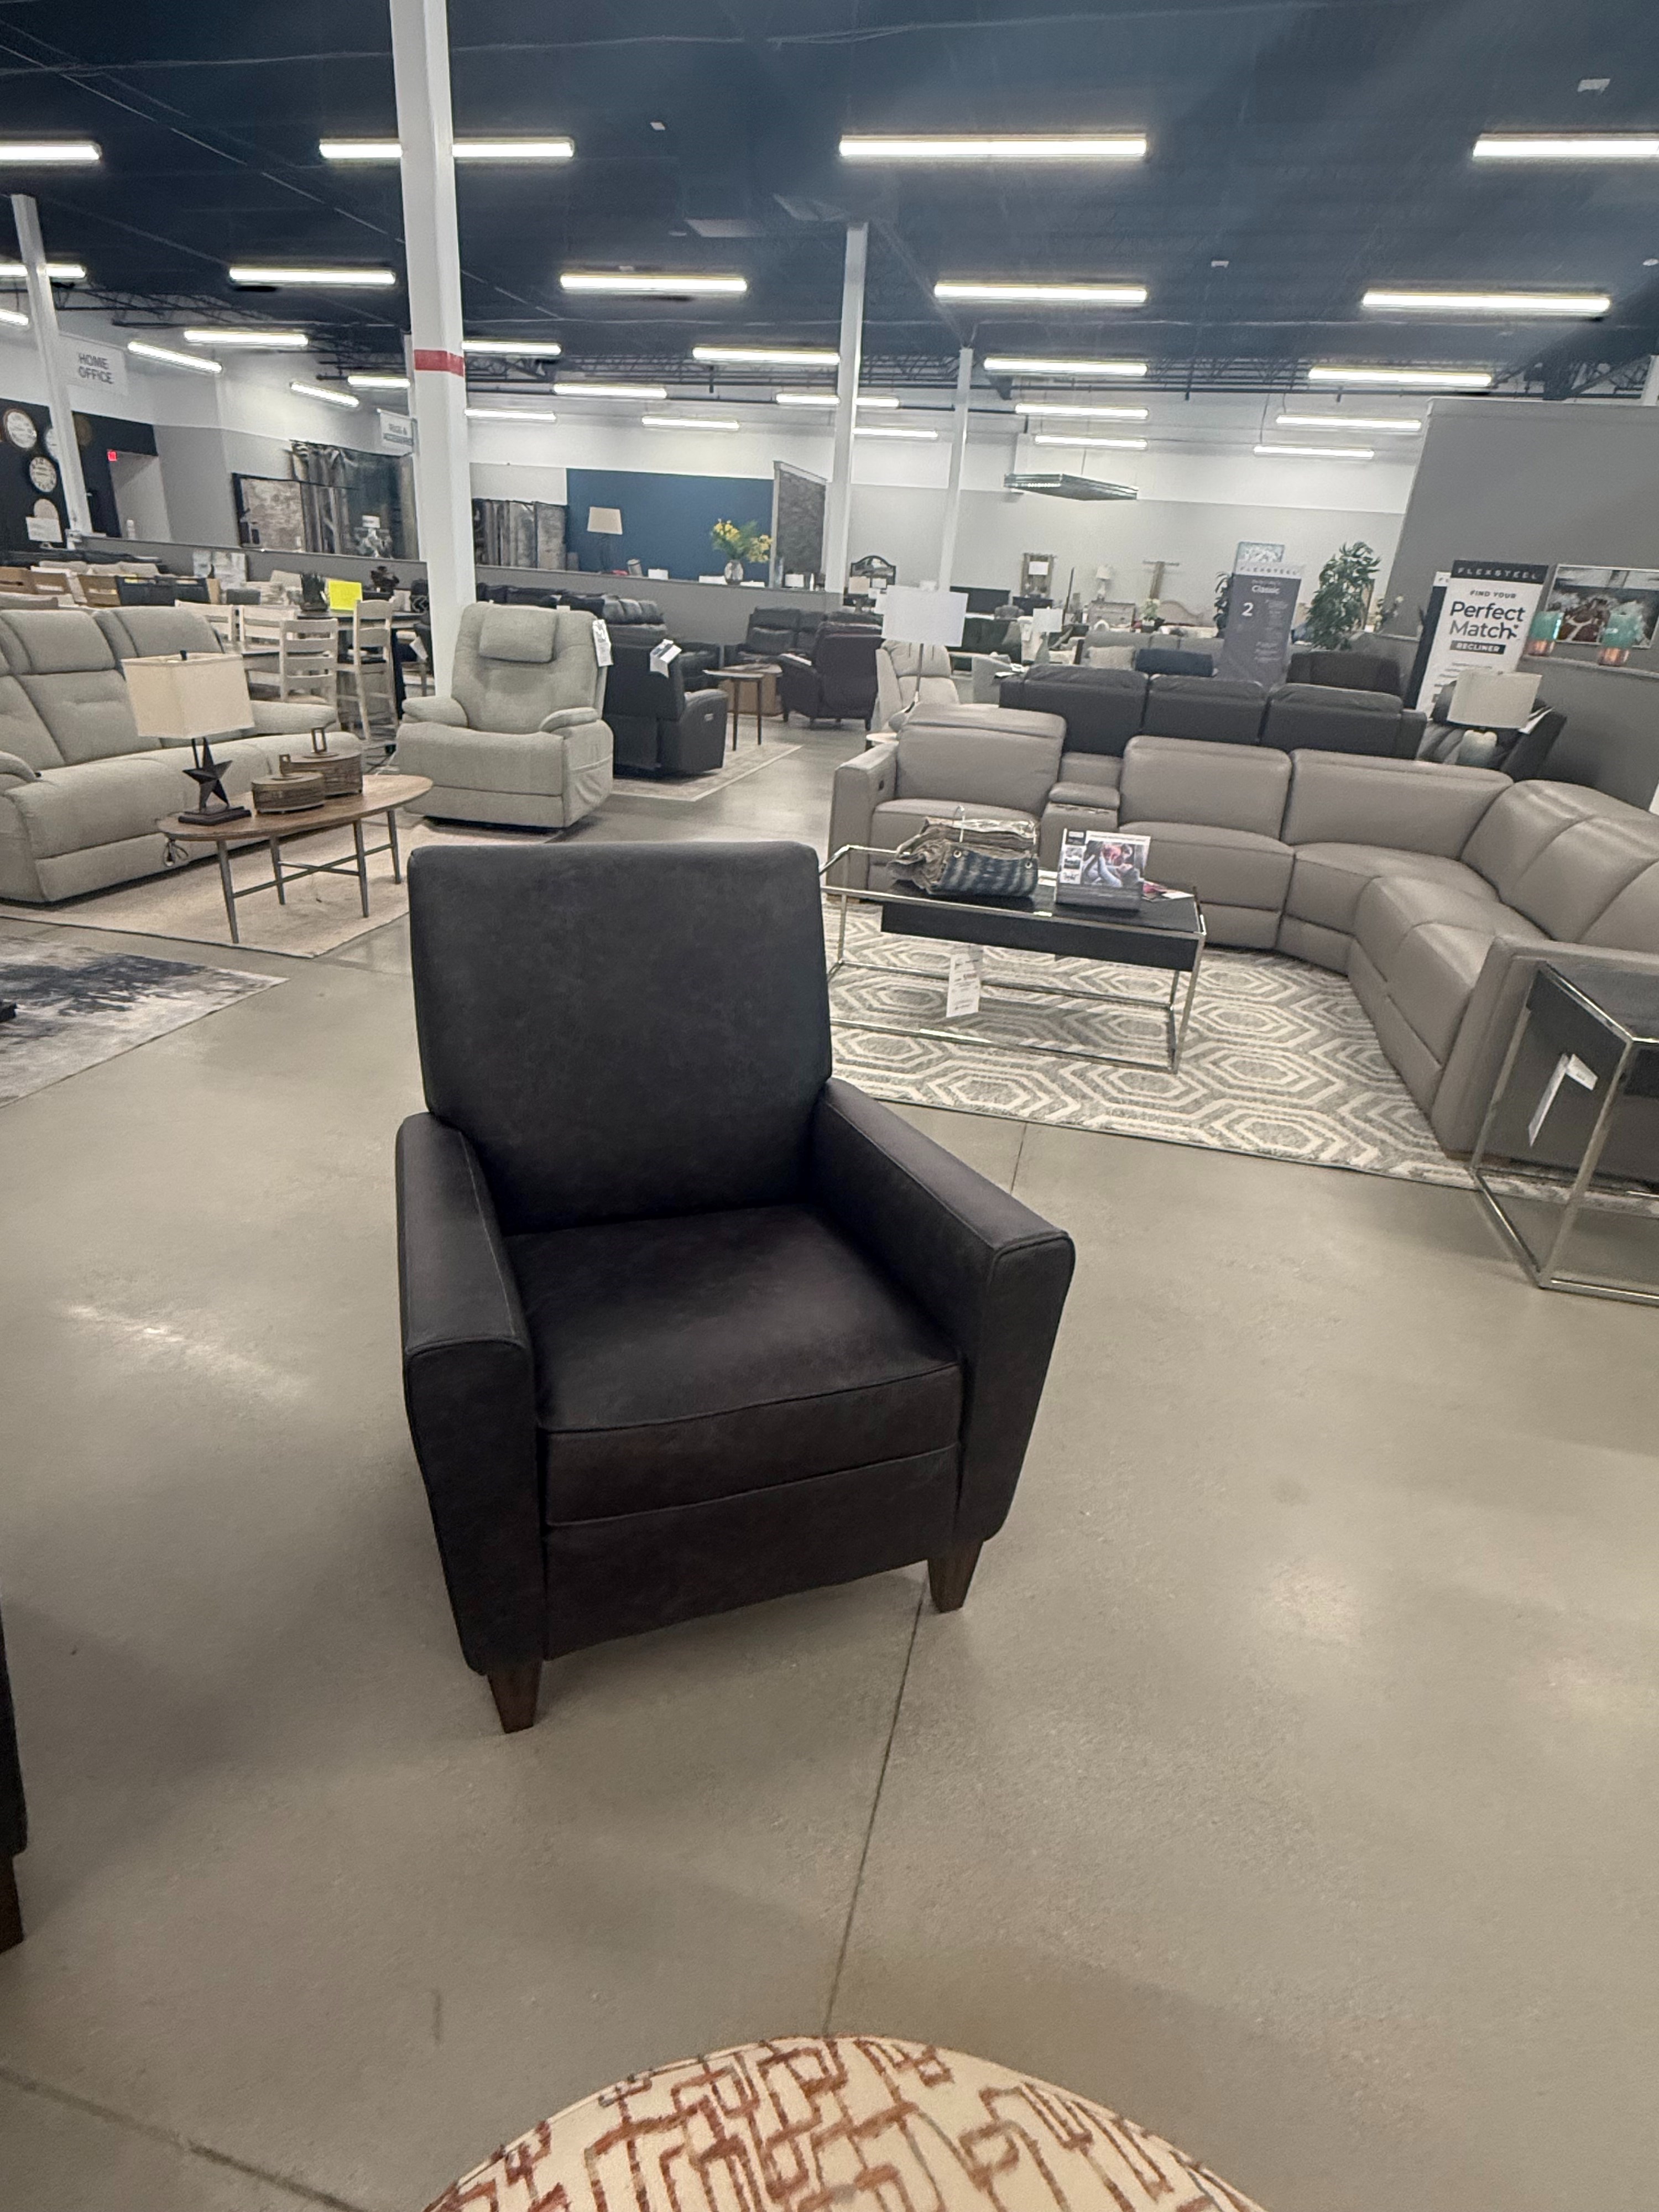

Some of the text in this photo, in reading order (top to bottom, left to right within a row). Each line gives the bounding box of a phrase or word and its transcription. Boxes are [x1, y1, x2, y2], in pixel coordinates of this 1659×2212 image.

[79, 353, 108, 369] HOME
[79, 366, 113, 384] OFFICE
[1458, 567, 1537, 580] FLEXSTEEL
[1241, 602, 1254, 617] 2
[1450, 601, 1525, 622] Perfect
[1449, 619, 1517, 640] Match
[1456, 643, 1500, 652] RECLINER
